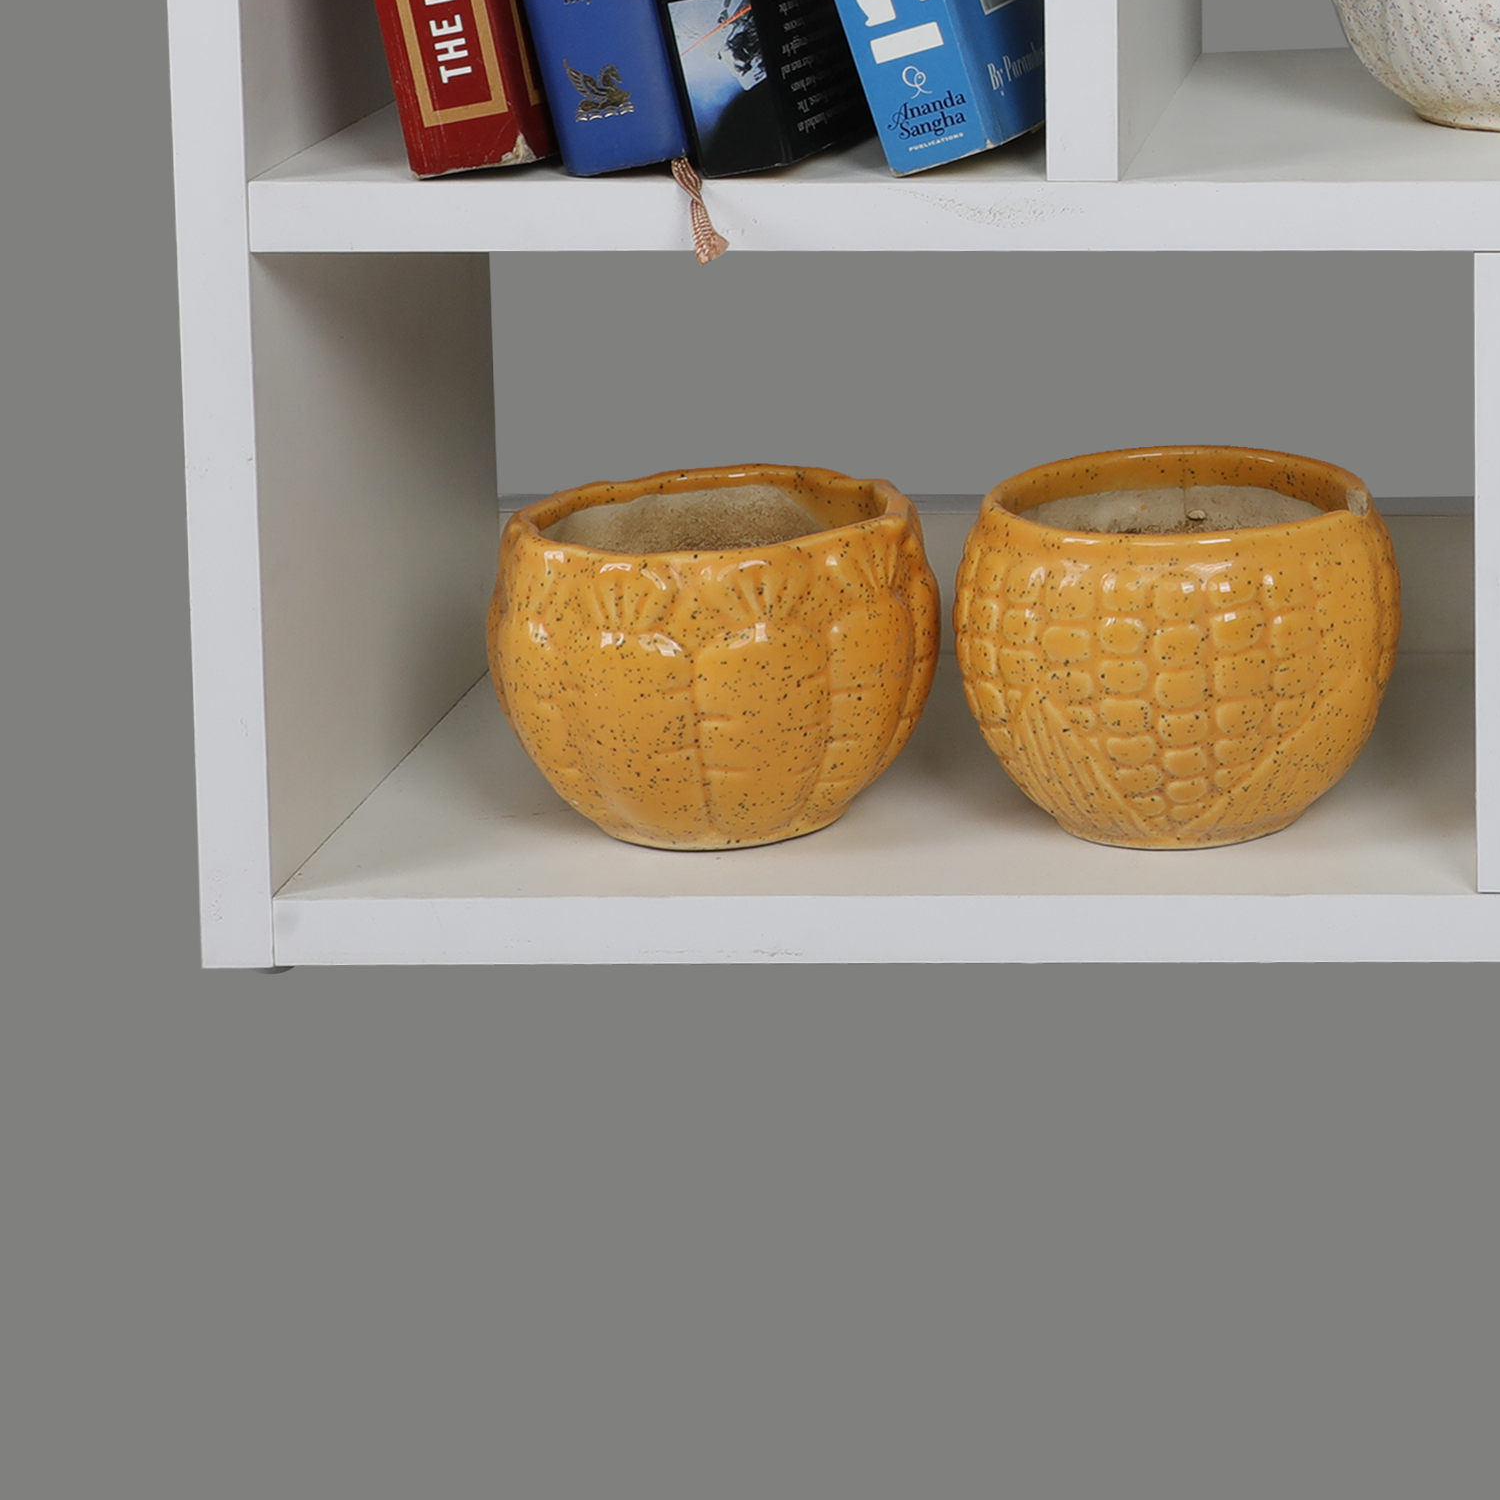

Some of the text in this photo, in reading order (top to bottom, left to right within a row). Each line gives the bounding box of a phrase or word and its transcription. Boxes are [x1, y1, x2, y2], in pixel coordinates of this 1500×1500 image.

[429, 15, 473, 84] THE
[987, 63, 1005, 97] By
[887, 89, 967, 131] Ananda
[898, 110, 967, 141] Sangha
[908, 132, 965, 152] PUBLICATIONS
